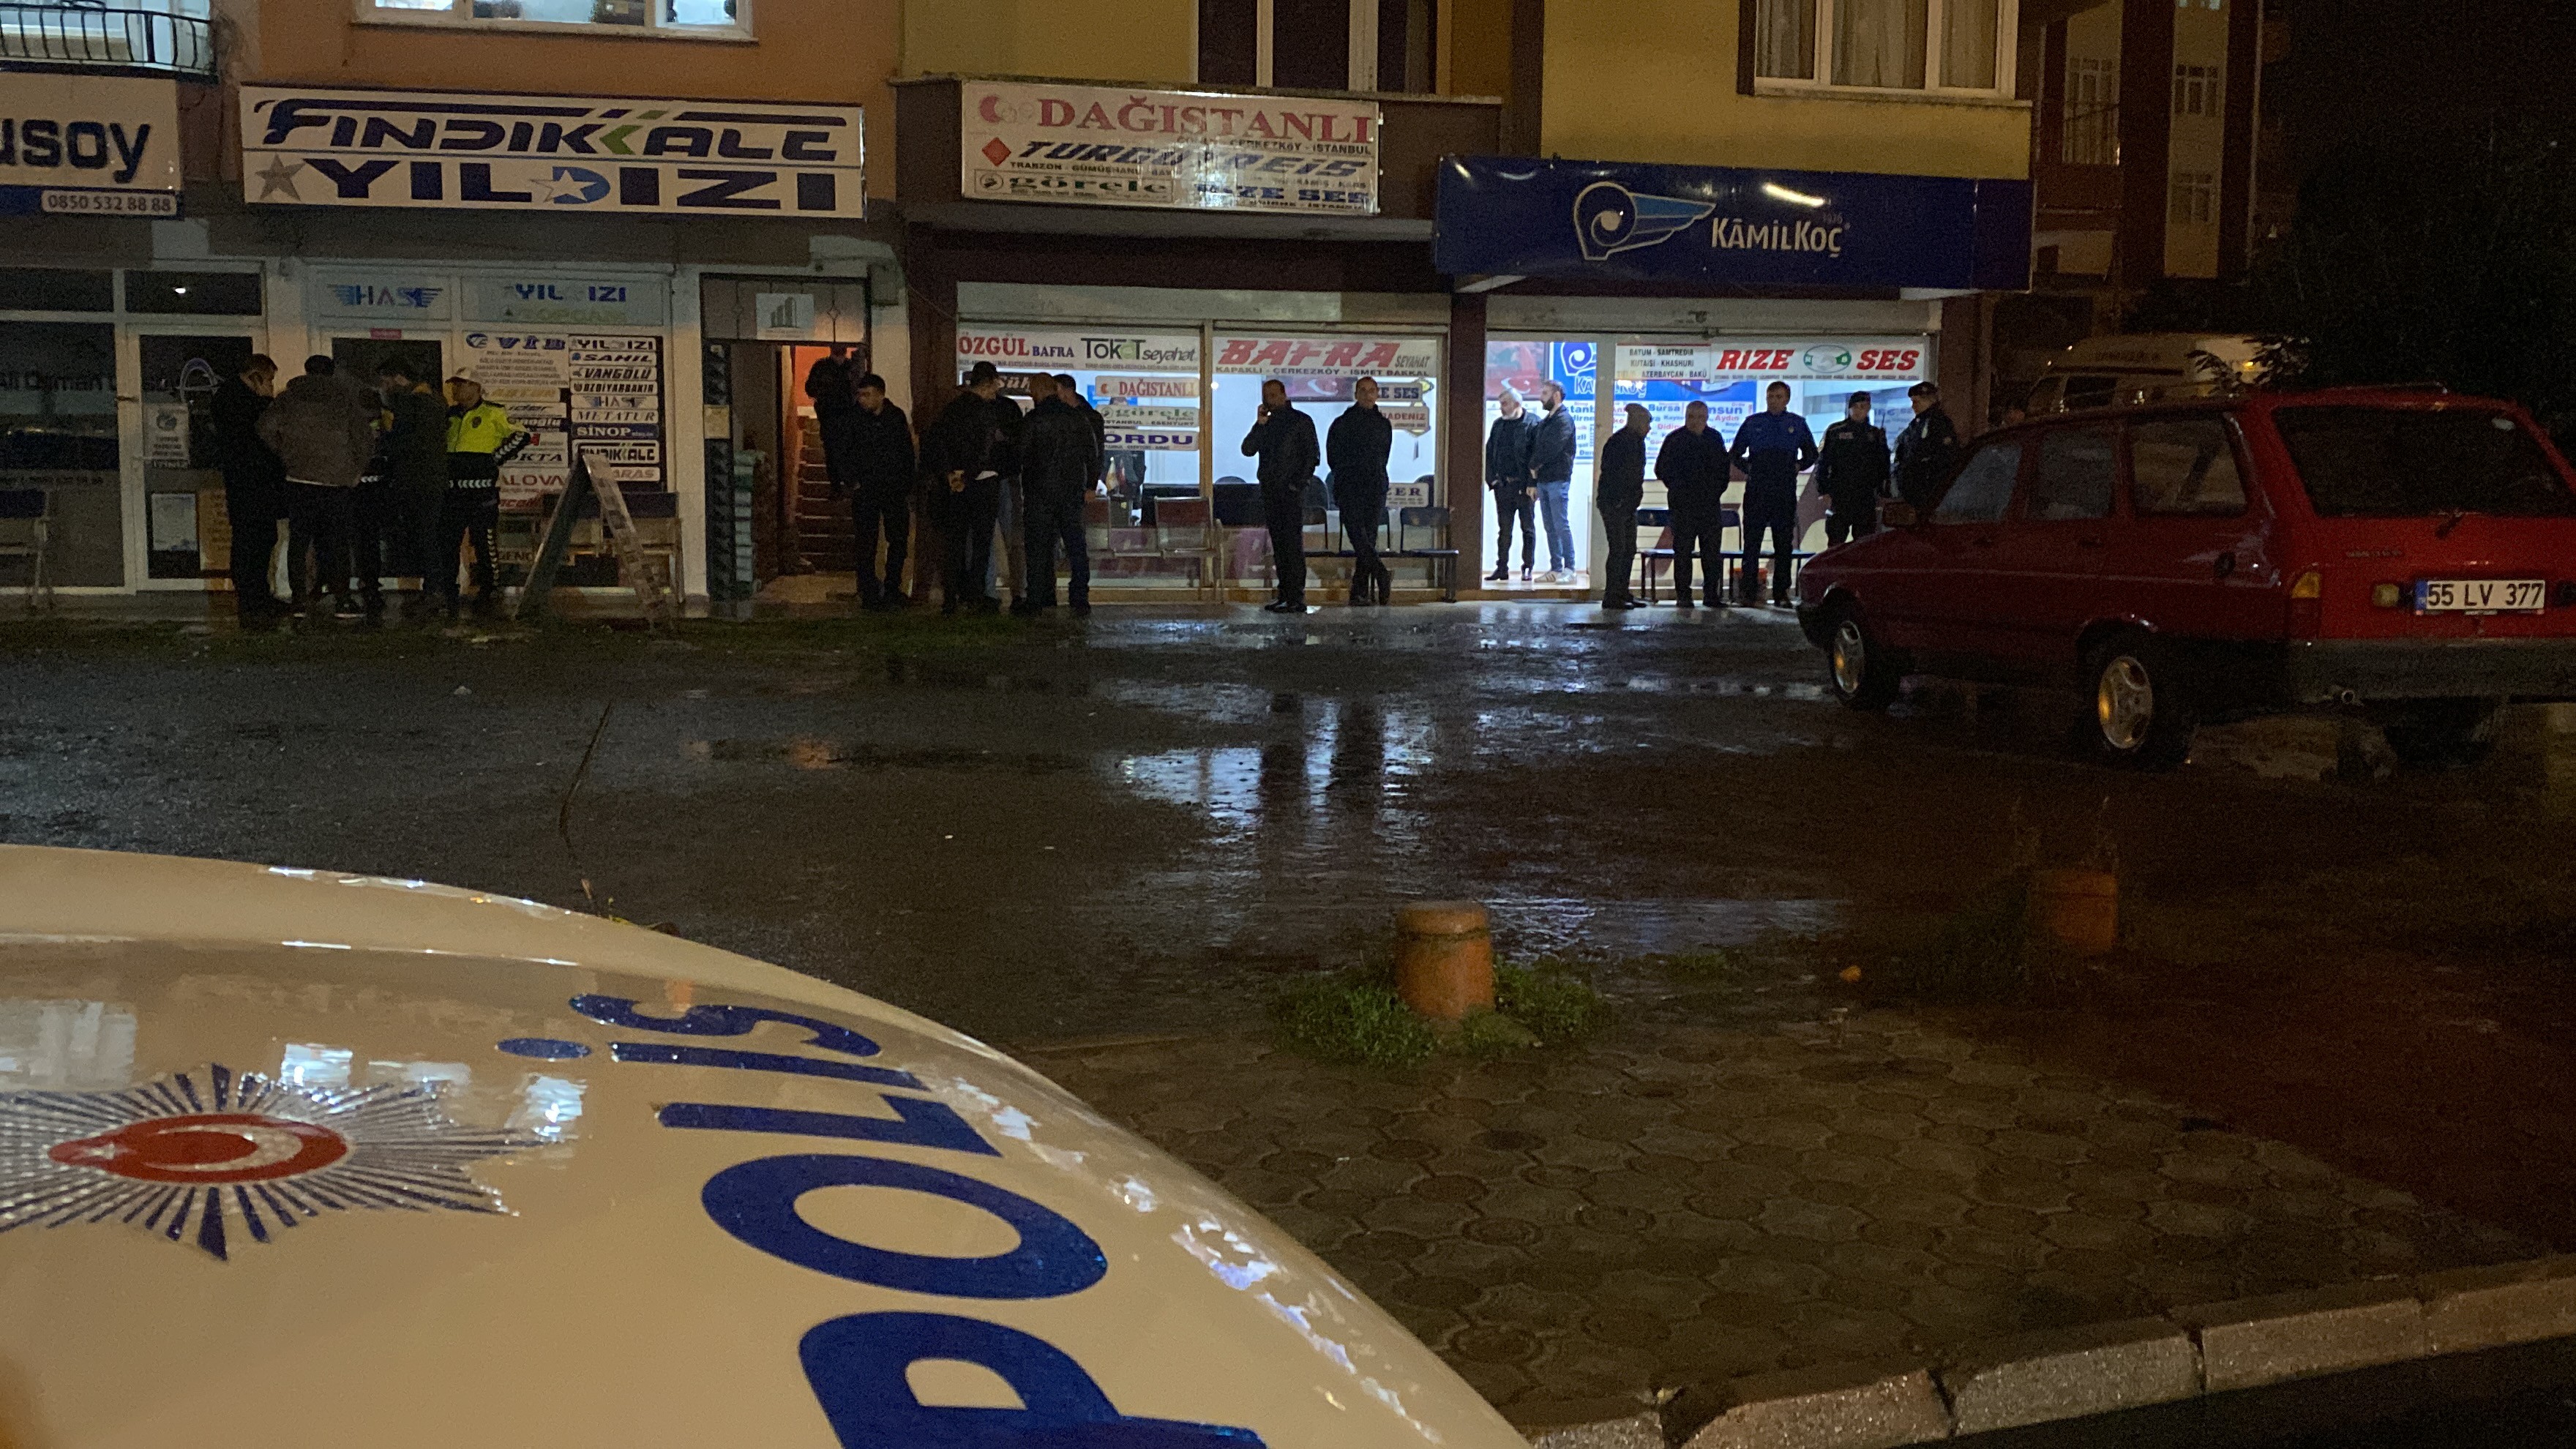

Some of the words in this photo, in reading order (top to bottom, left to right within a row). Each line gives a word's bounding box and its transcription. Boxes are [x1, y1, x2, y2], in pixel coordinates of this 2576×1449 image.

[1019, 141, 1213, 165] TURGU
[304, 158, 836, 211] YILDIZI
[48, 195, 89, 209] 0850
[94, 196, 122, 211] 532
[127, 197, 147, 211] 88
[151, 198, 171, 212] 88
[514, 283, 626, 303] YILIZI
[958, 332, 1030, 356] ÖZGÜL
[1033, 345, 1074, 358] BAFRA
[1218, 339, 1401, 367] BAFRA
[1856, 350, 1920, 371] SES
[1393, 387, 1419, 399] SES
[1648, 403, 1680, 412] Bursa
[1104, 433, 1193, 445] ORDU
[2428, 583, 2454, 606] 55
[2464, 583, 2493, 607] LV
[2505, 583, 2544, 606] 377
